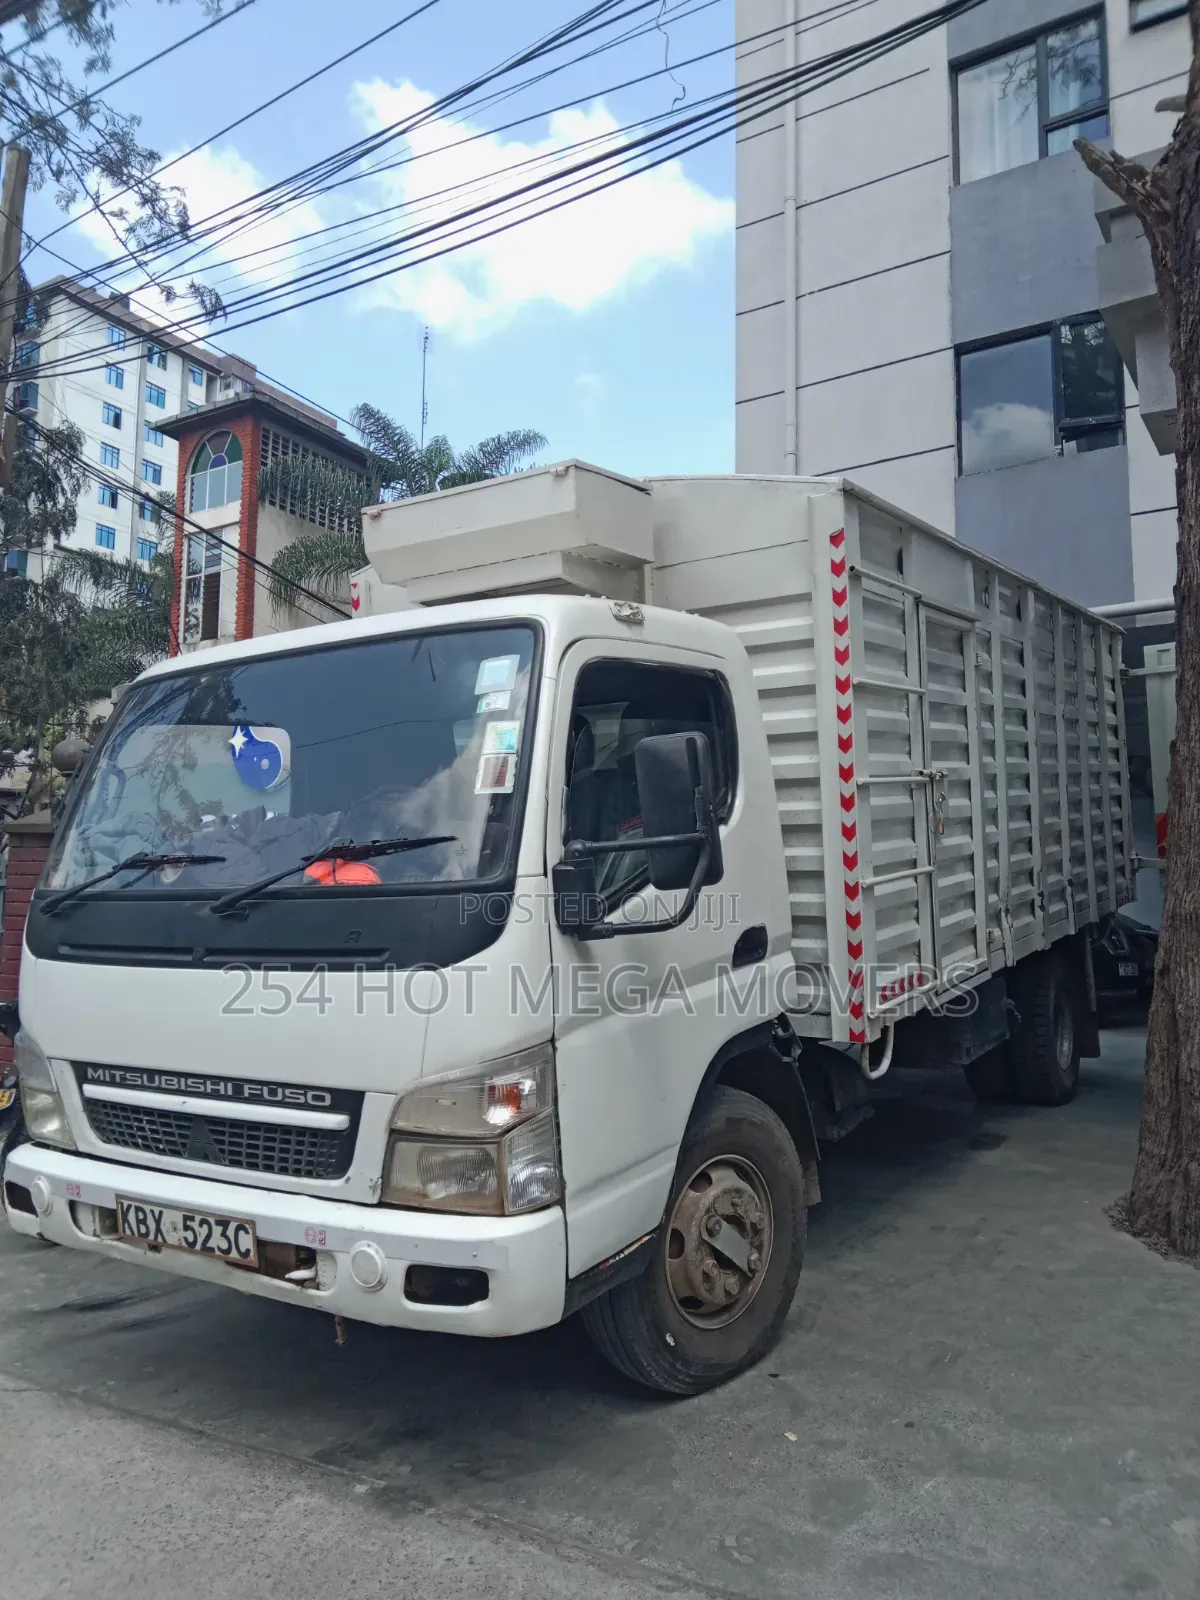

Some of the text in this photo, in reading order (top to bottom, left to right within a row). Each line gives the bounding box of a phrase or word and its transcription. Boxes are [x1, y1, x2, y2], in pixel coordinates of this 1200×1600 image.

[87, 1067, 332, 1107] MITSUBISHI FUSO
[120, 1201, 167, 1244] KBX
[182, 1213, 252, 1260] 523C
